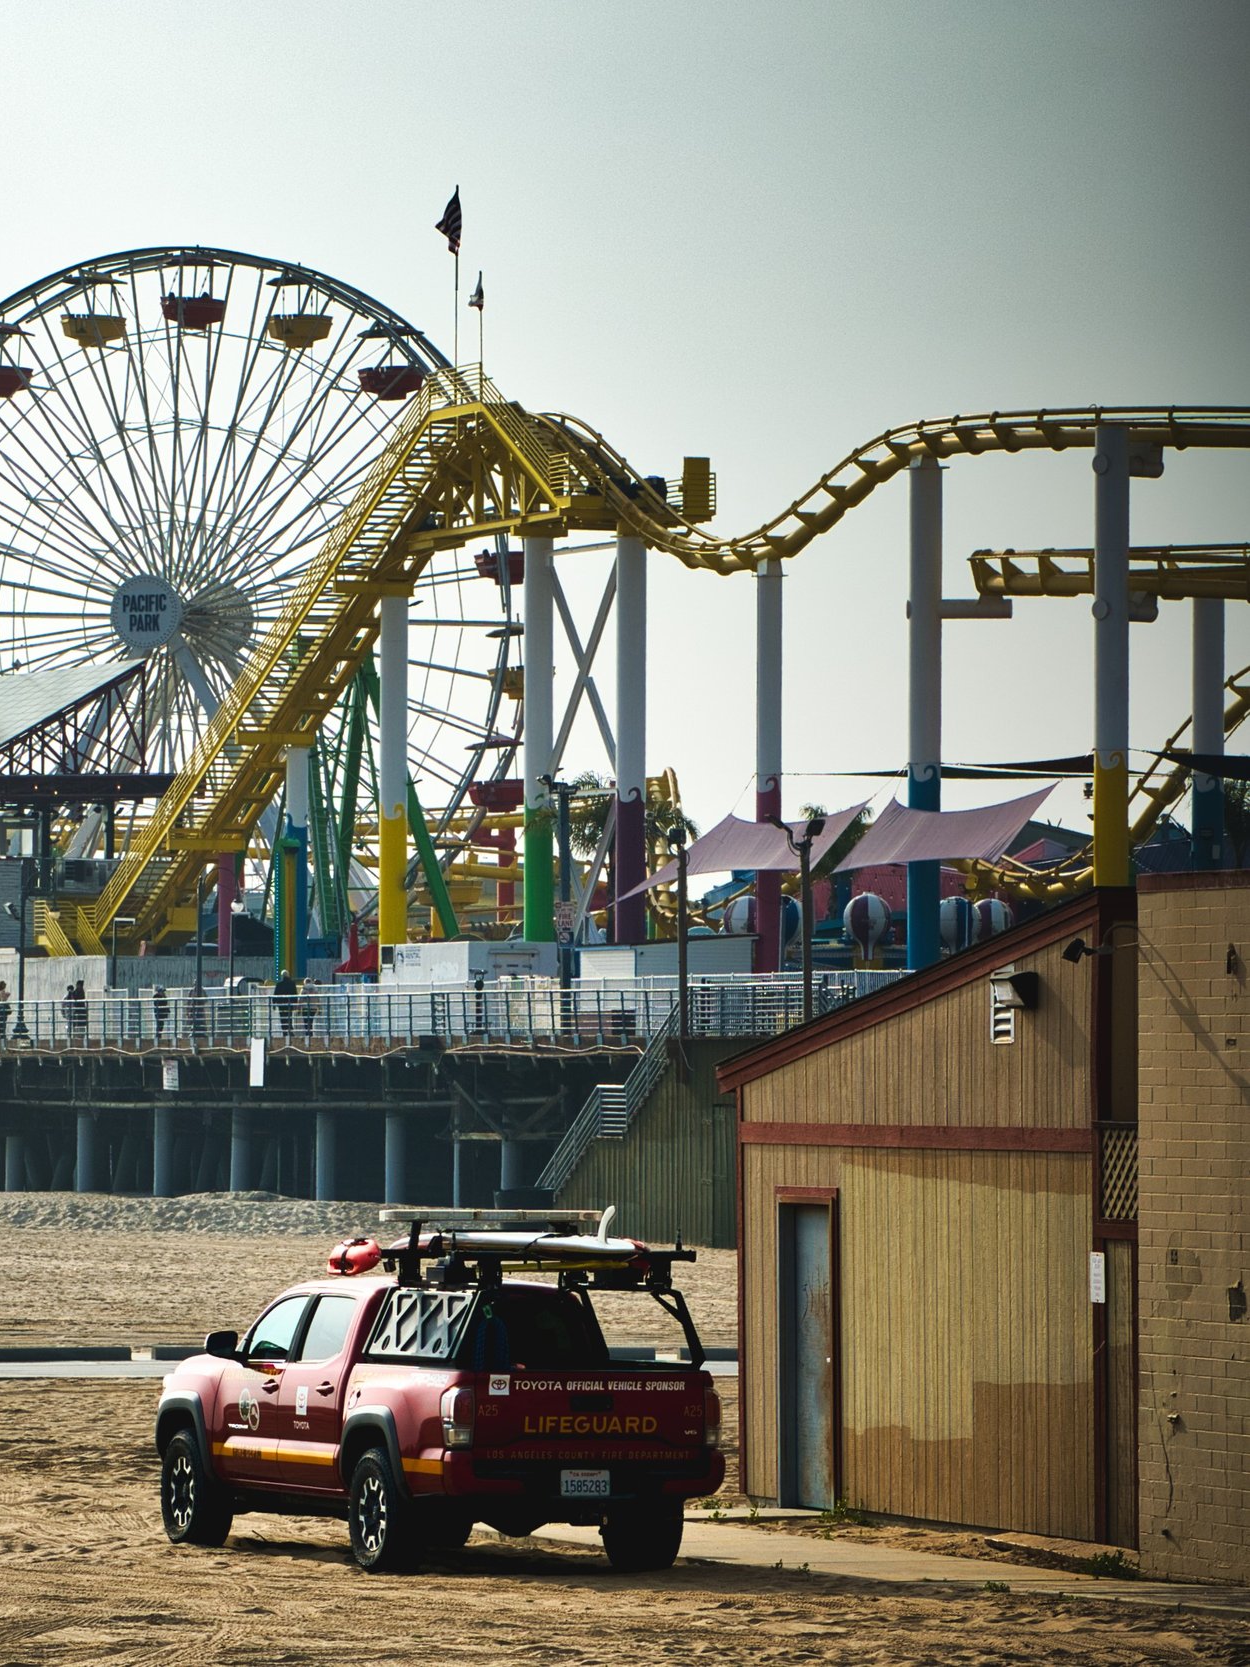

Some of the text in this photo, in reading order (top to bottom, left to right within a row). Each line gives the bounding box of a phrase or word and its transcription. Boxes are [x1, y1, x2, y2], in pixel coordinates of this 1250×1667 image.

[122, 594, 167, 613] PACIFIC
[129, 614, 160, 632] PARK
[514, 1380, 686, 1391] TOYOTA OFFICIAL VEHICLE SPONSOR
[478, 1404, 499, 1417] A25
[683, 1404, 703, 1417] A25
[293, 1421, 310, 1430] TOYOTA
[524, 1416, 658, 1434] LIFEGUARD
[486, 1450, 690, 1460] LOS ANGELES COUNTY FIRE DEPARTMENT
[564, 1480, 608, 1493] 1585283
